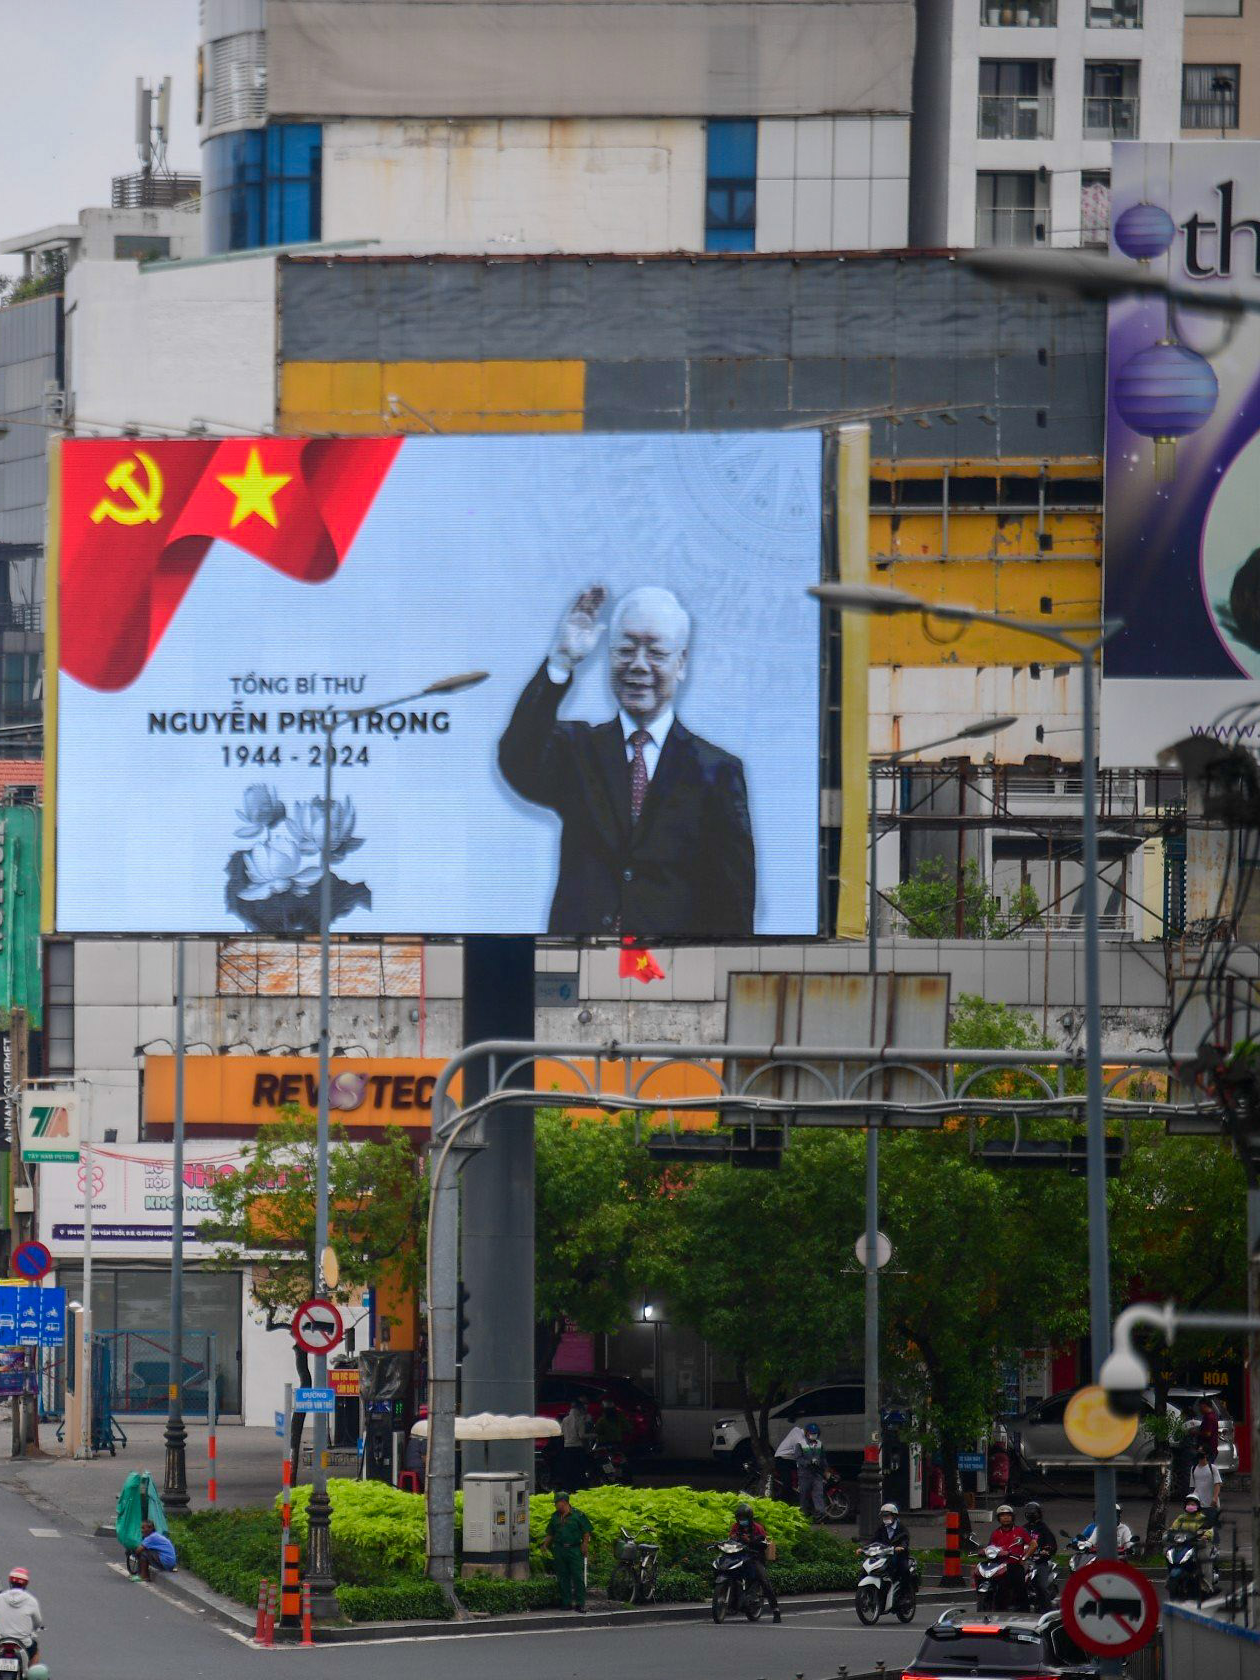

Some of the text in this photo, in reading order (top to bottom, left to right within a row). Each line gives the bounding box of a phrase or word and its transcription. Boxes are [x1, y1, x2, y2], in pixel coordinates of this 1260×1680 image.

[230, 671, 367, 694] TỔNG BÍ THƯ
[148, 701, 451, 741] NGUYỄN PHÚ TRỌNG
[222, 746, 282, 767] 1944
[309, 746, 370, 767] 2024
